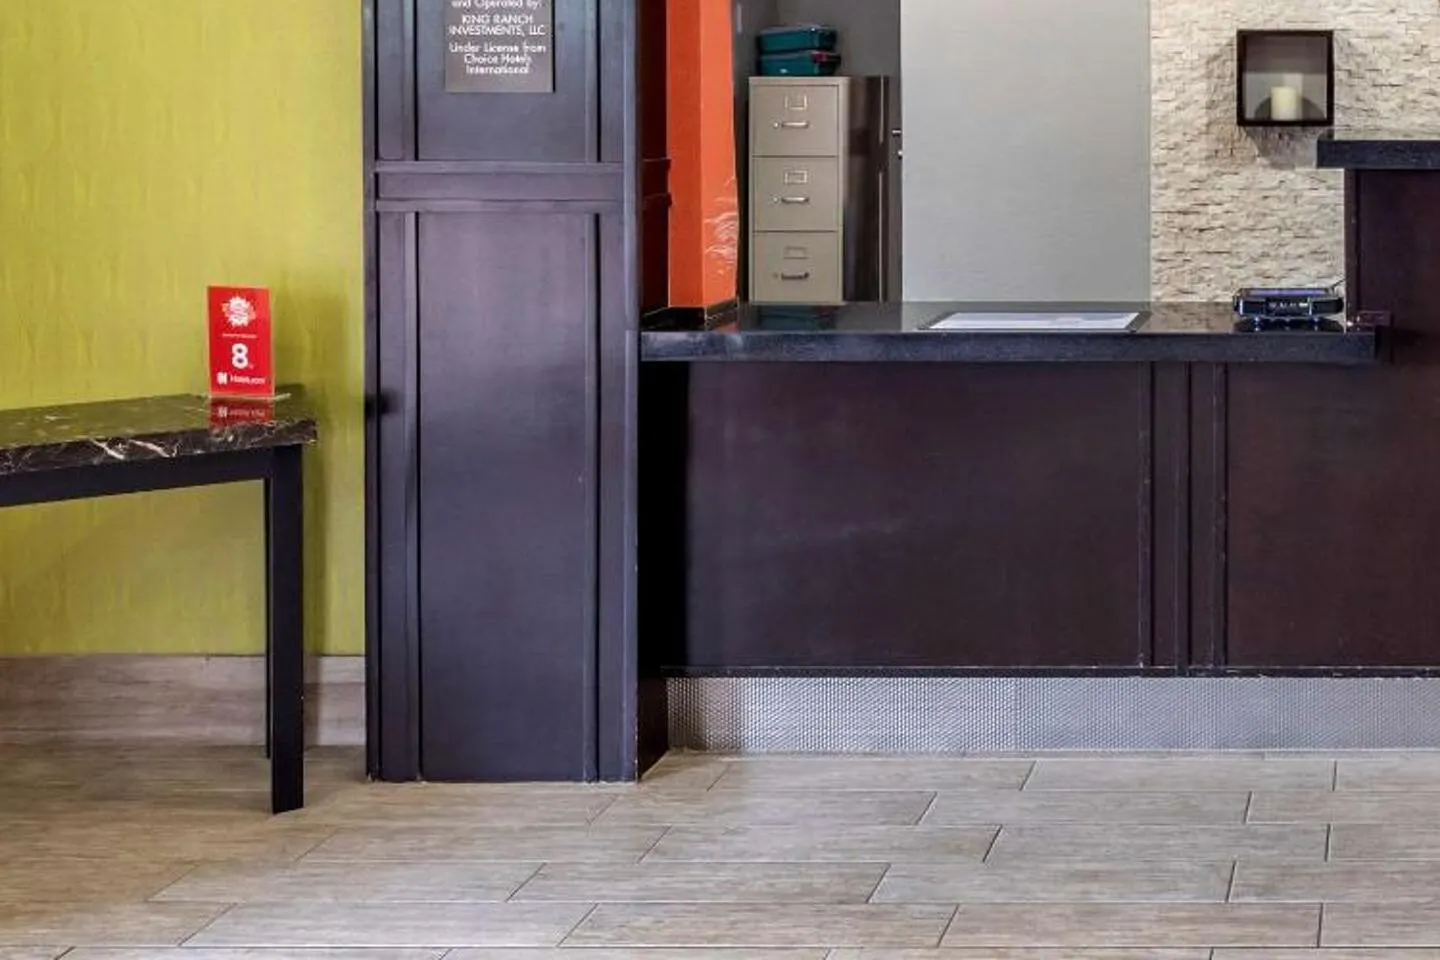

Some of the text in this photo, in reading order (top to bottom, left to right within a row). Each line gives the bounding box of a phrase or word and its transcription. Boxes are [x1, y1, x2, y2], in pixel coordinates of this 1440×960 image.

[462, 14, 533, 24] KING RANCH
[529, 25, 546, 35] LLC
[449, 42, 546, 53] Under License from
[464, 53, 532, 64] Choice Hotels
[466, 64, 529, 74] International
[232, 343, 249, 369] 8
